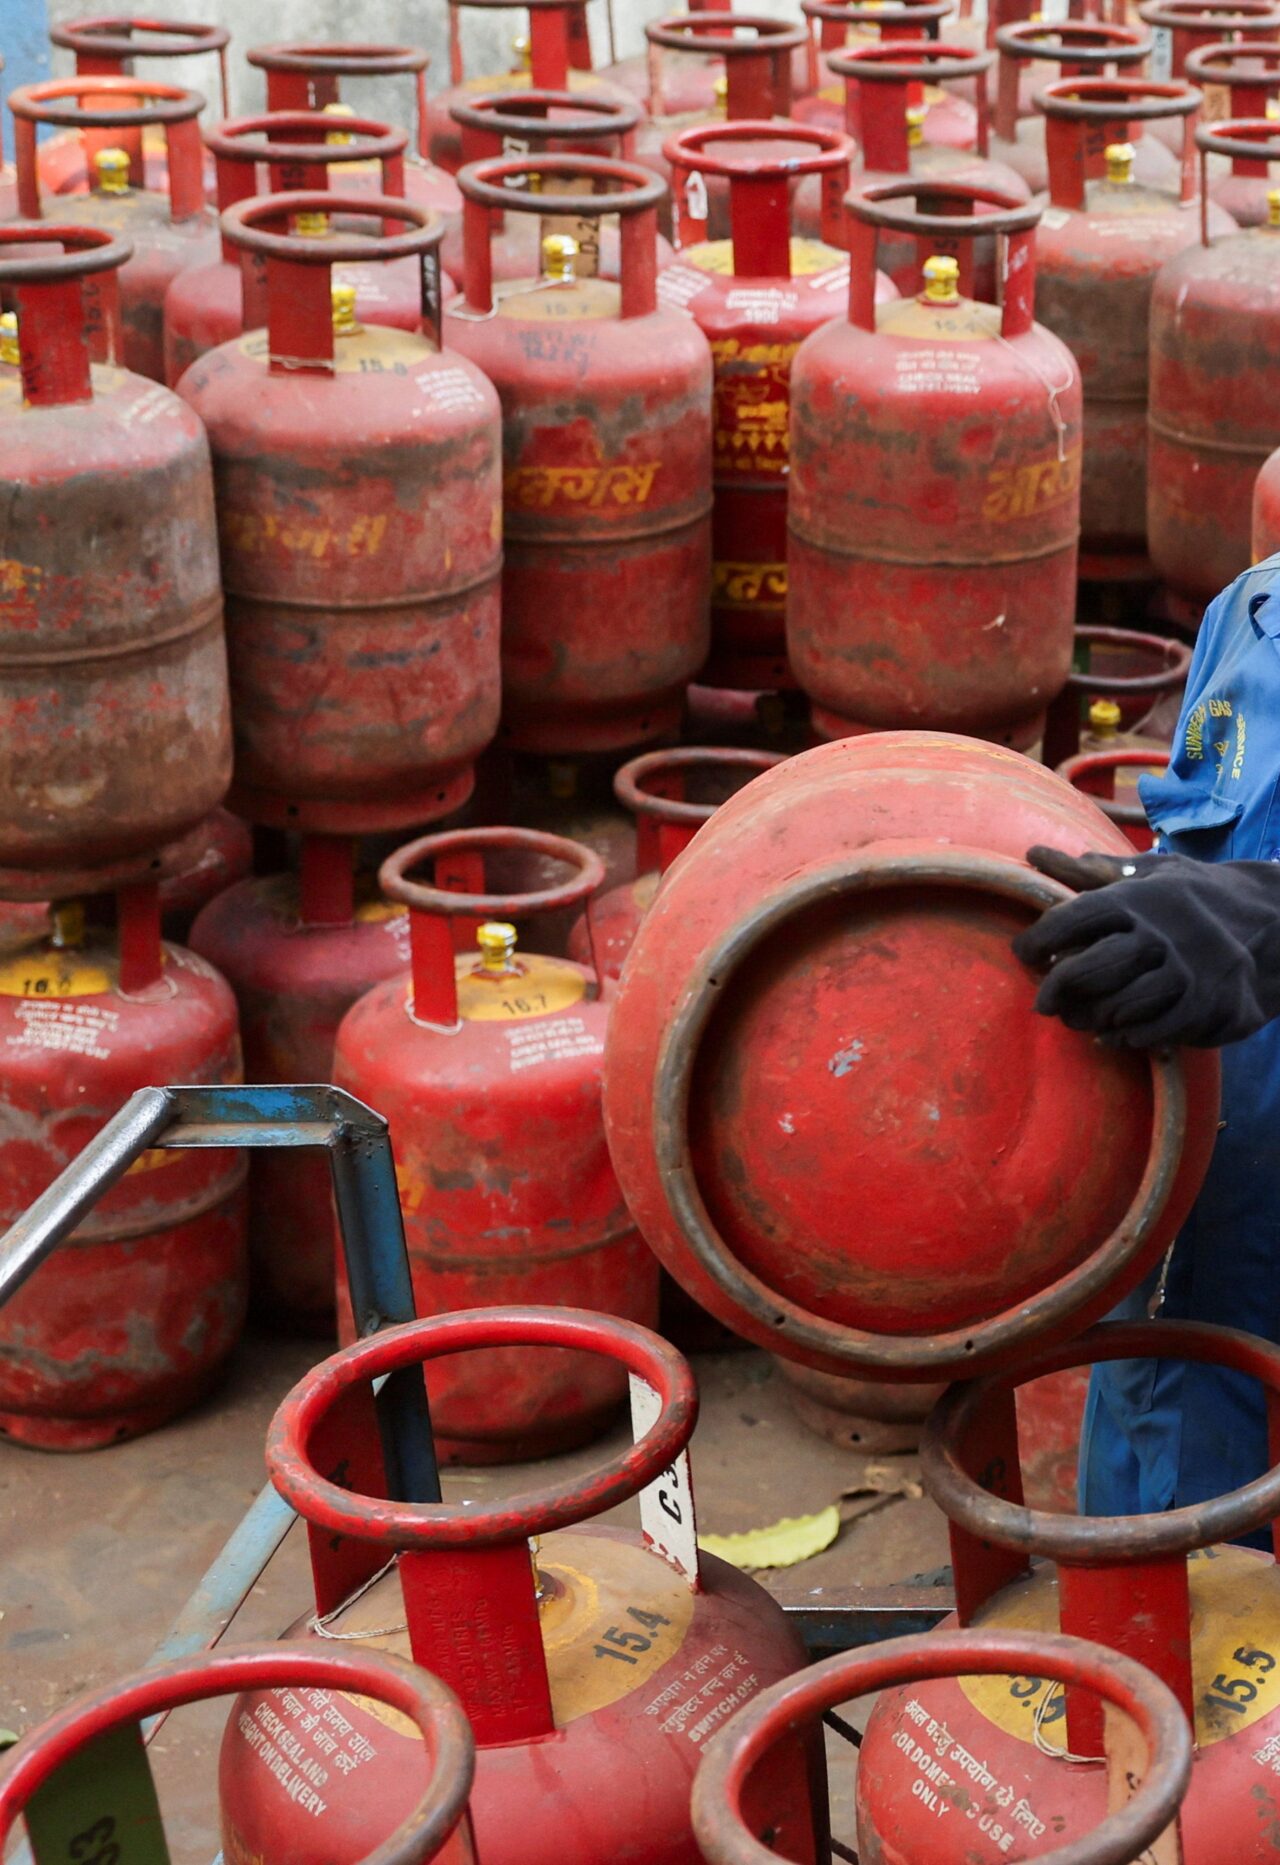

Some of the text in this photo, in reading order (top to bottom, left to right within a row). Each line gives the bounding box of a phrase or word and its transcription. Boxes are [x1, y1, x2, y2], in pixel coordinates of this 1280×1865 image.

[1209, 699, 1232, 717] GAS
[593, 1606, 671, 1665] 15.4
[1204, 1646, 1277, 1714] 15.5
[300, 1712, 321, 1734] की
[322, 1705, 354, 1737] समय
[687, 1692, 741, 1743] SWITCH
[237, 1711, 328, 1817] WEIGHT ON DELIVERY
[254, 1701, 329, 1788] CHECK SEAL AND
[911, 1778, 951, 1818] ONLY
[949, 1744, 999, 1792] उपयोग
[1009, 1798, 1048, 1840] लिए
[977, 1812, 1016, 1852] USE
